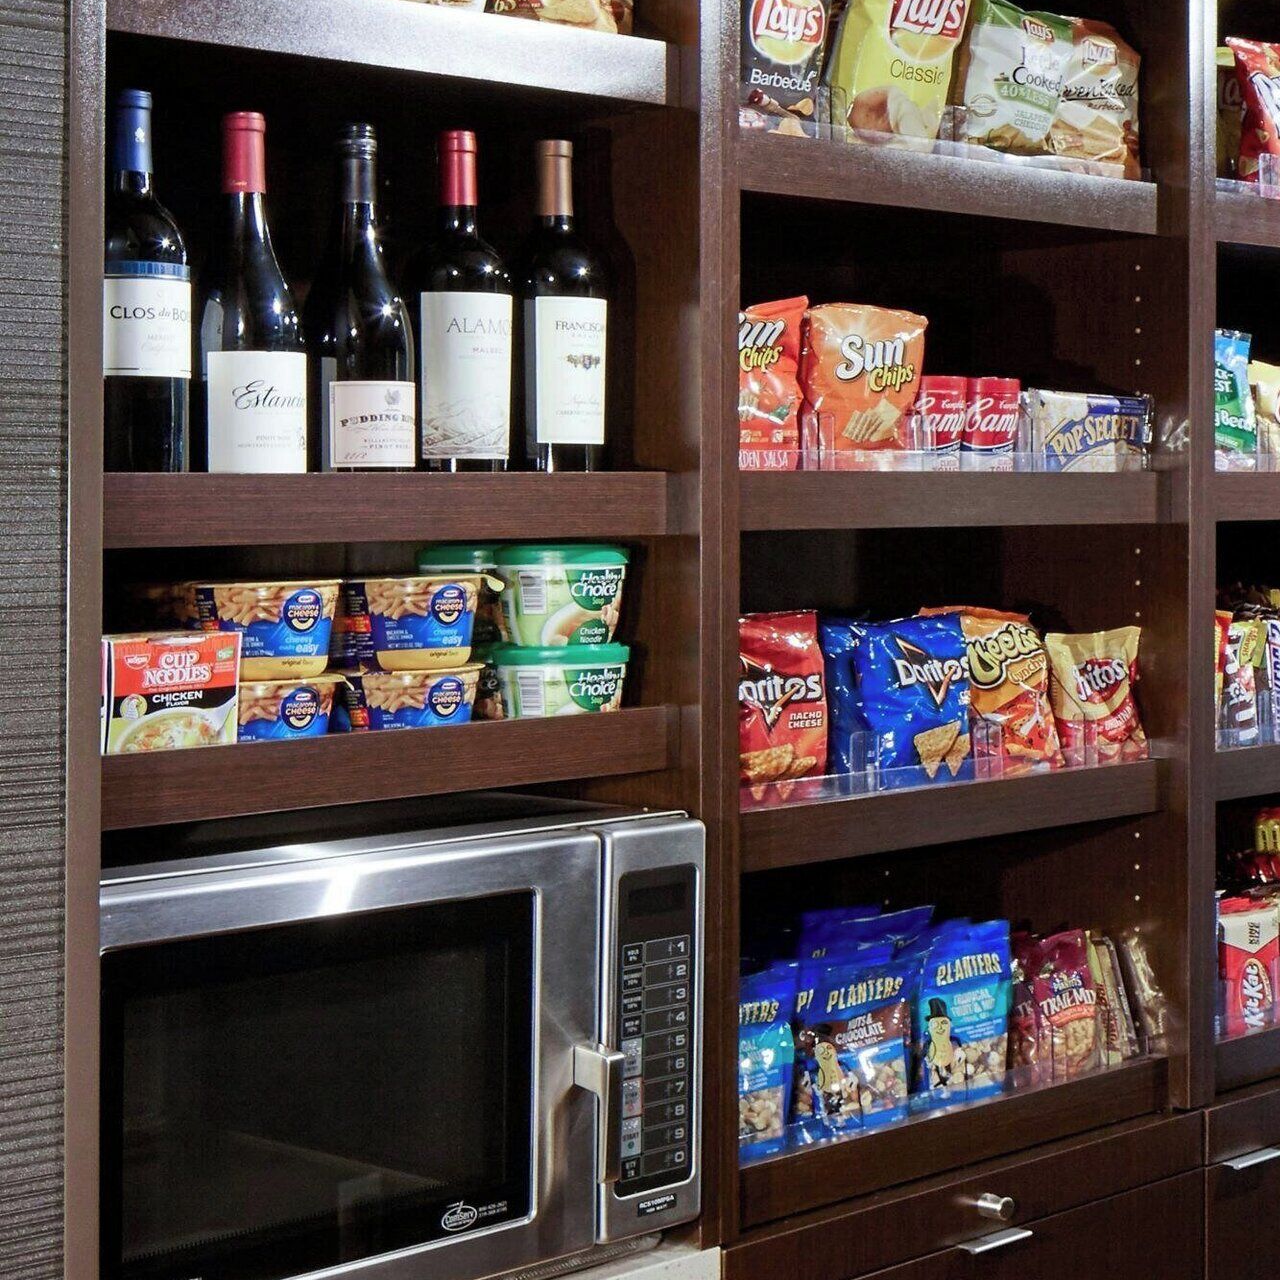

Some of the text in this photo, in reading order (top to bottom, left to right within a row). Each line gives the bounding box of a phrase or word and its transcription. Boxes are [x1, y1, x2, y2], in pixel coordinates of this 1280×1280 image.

[890, 59, 945, 85] Classic
[750, 69, 813, 91] Barbecue
[1013, 66, 1062, 95] Cooked
[110, 305, 156, 321] CLOS
[740, 346, 782, 371] Chips
[836, 334, 906, 380] Sun
[869, 364, 914, 392] Chips
[340, 414, 399, 428] PUDDING
[581, 570, 620, 584] Healthy
[571, 582, 617, 597] Choice
[580, 627, 606, 636] Chicken
[442, 635, 463, 647] easy
[295, 642, 320, 656] easy
[160, 651, 199, 670] CUP
[144, 663, 211, 688] NOODLES
[578, 668, 620, 683] Healthy
[896, 655, 970, 687] Doritos
[569, 681, 616, 697] Choice
[152, 690, 203, 703] CHICKEN
[789, 711, 823, 720] NACHO
[788, 719, 823, 729] CHEESE
[677, 942, 686, 952] 1
[676, 964, 686, 976] 2
[935, 952, 1002, 987] PLANTERS
[676, 988, 686, 1000] 3
[826, 977, 904, 1014] PLANTERS
[676, 1011, 686, 1022] 4
[674, 1034, 686, 1047] 5
[835, 1022, 886, 1045] CHOCOLATE
[674, 1057, 686, 1070] 6
[674, 1081, 686, 1093] 7
[674, 1104, 686, 1117] 8
[622, 1131, 639, 1142] START
[674, 1128, 686, 1140] 9
[674, 1150, 686, 1163] 0
